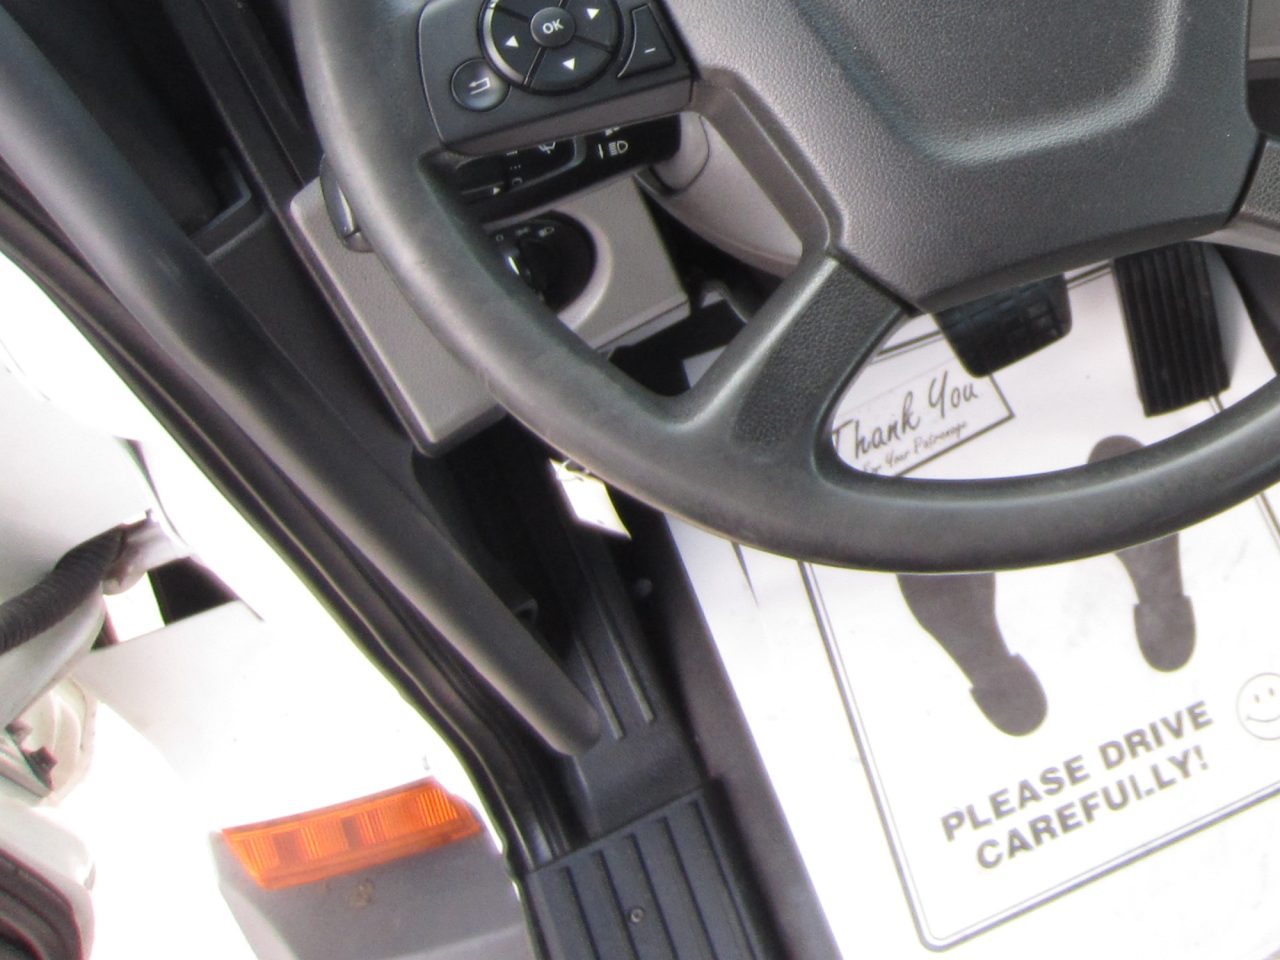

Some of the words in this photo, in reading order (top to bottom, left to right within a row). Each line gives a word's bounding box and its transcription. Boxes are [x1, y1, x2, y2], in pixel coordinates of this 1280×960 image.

[542, 18, 564, 35] OK
[832, 390, 921, 459] Thank
[928, 370, 979, 419] You
[941, 754, 1091, 843] PLEASE
[1098, 700, 1214, 772] DRIVE
[976, 744, 1210, 871] CAREFULLY!
